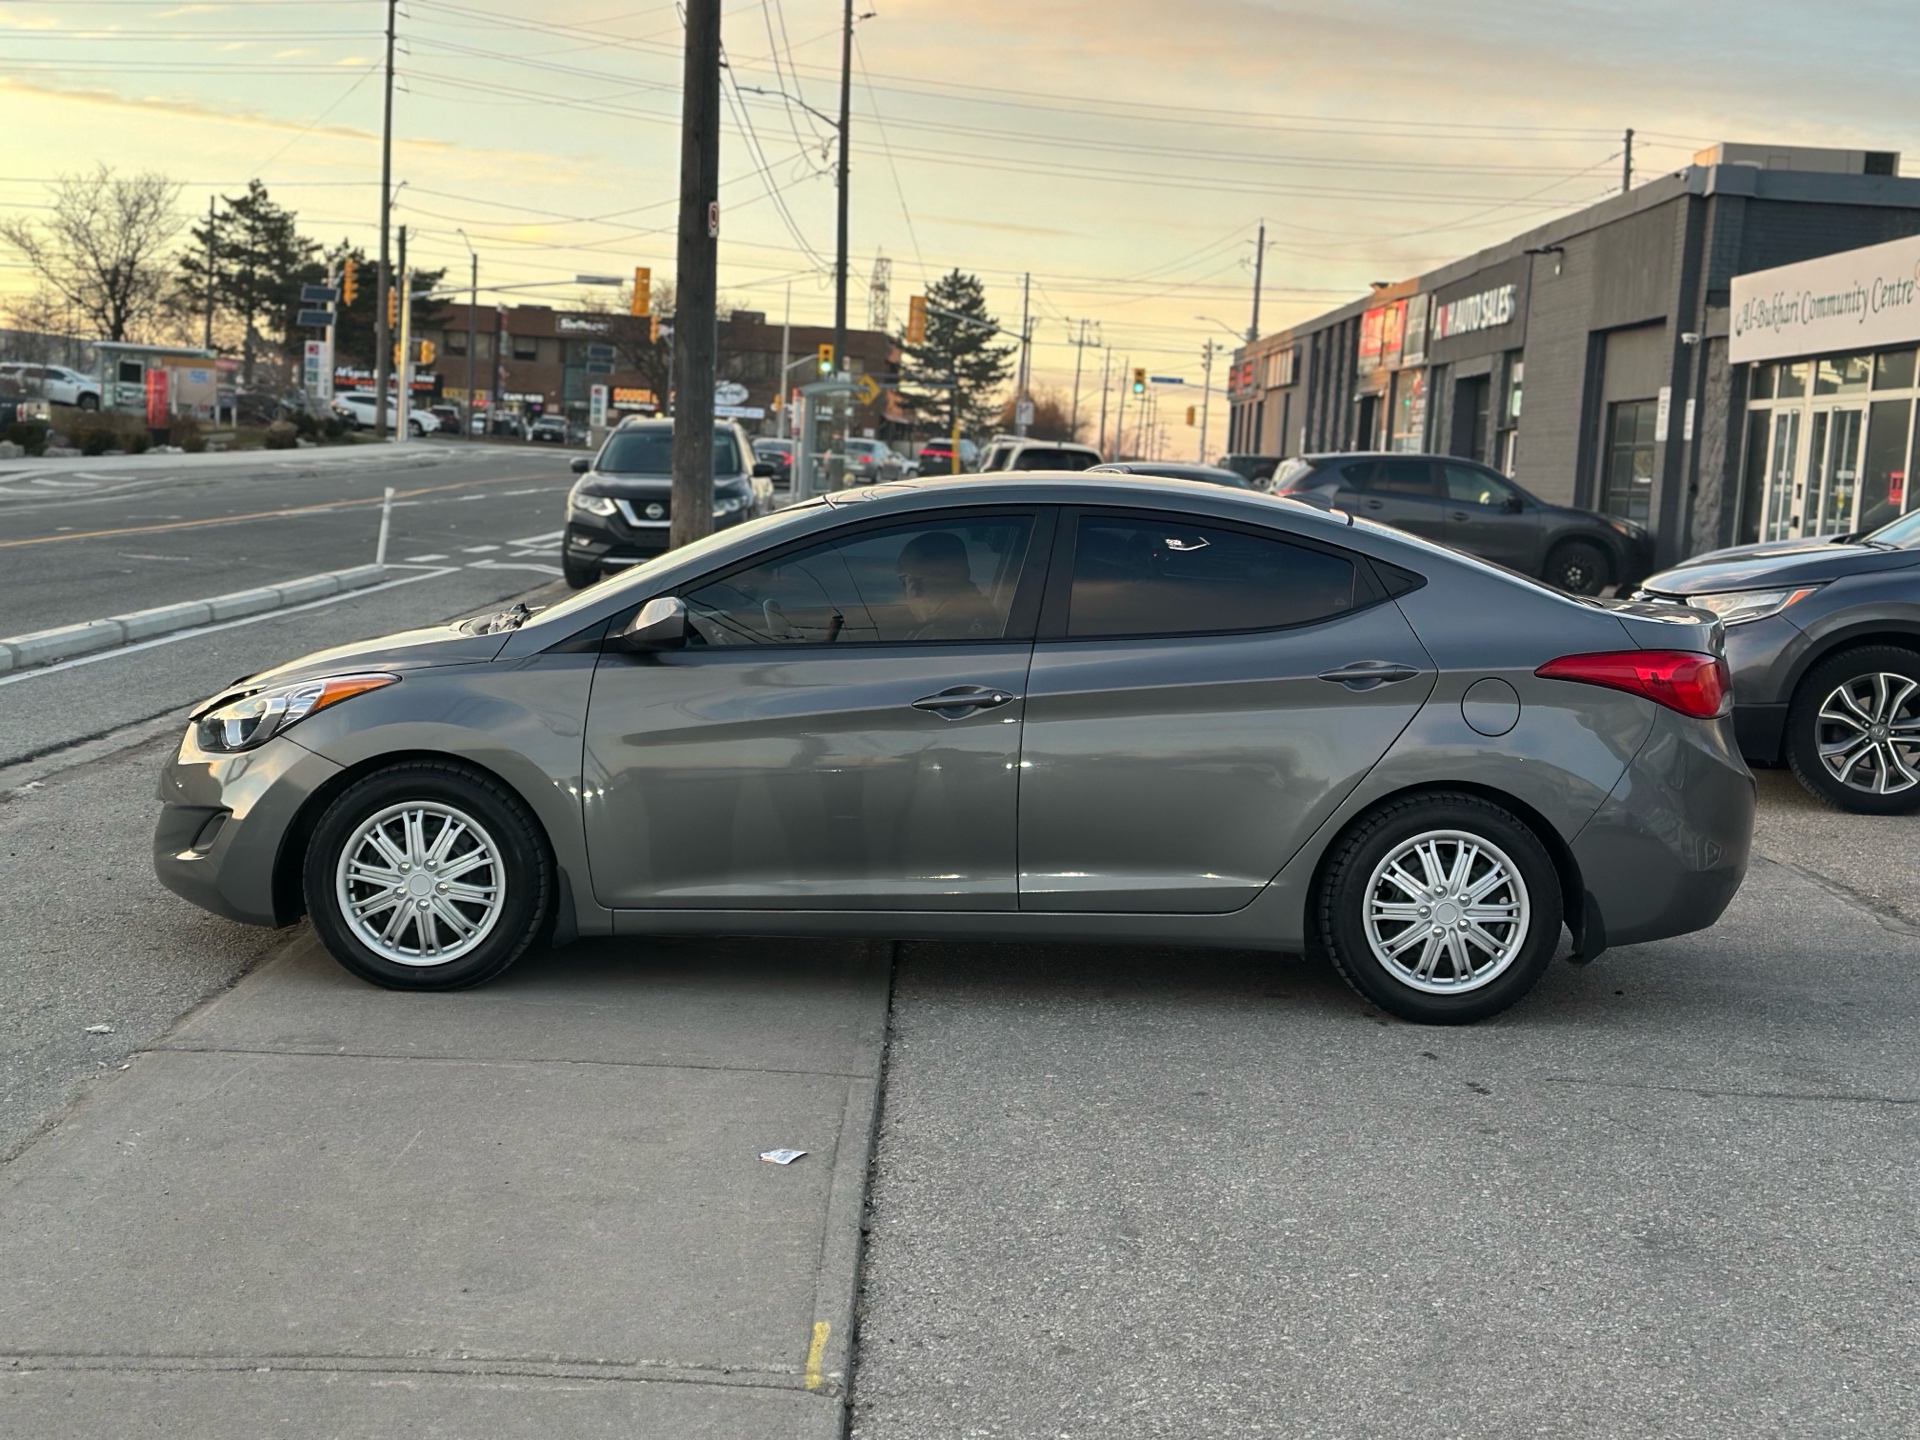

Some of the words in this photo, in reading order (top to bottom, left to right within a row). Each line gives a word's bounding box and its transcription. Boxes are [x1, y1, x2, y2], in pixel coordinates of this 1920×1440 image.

[1455, 293, 1481, 335] AUTO
[1480, 284, 1516, 330] SALES
[1735, 291, 1800, 337] Al-Bukhari
[1801, 280, 1869, 325] Community
[1871, 277, 1914, 314] Centre
